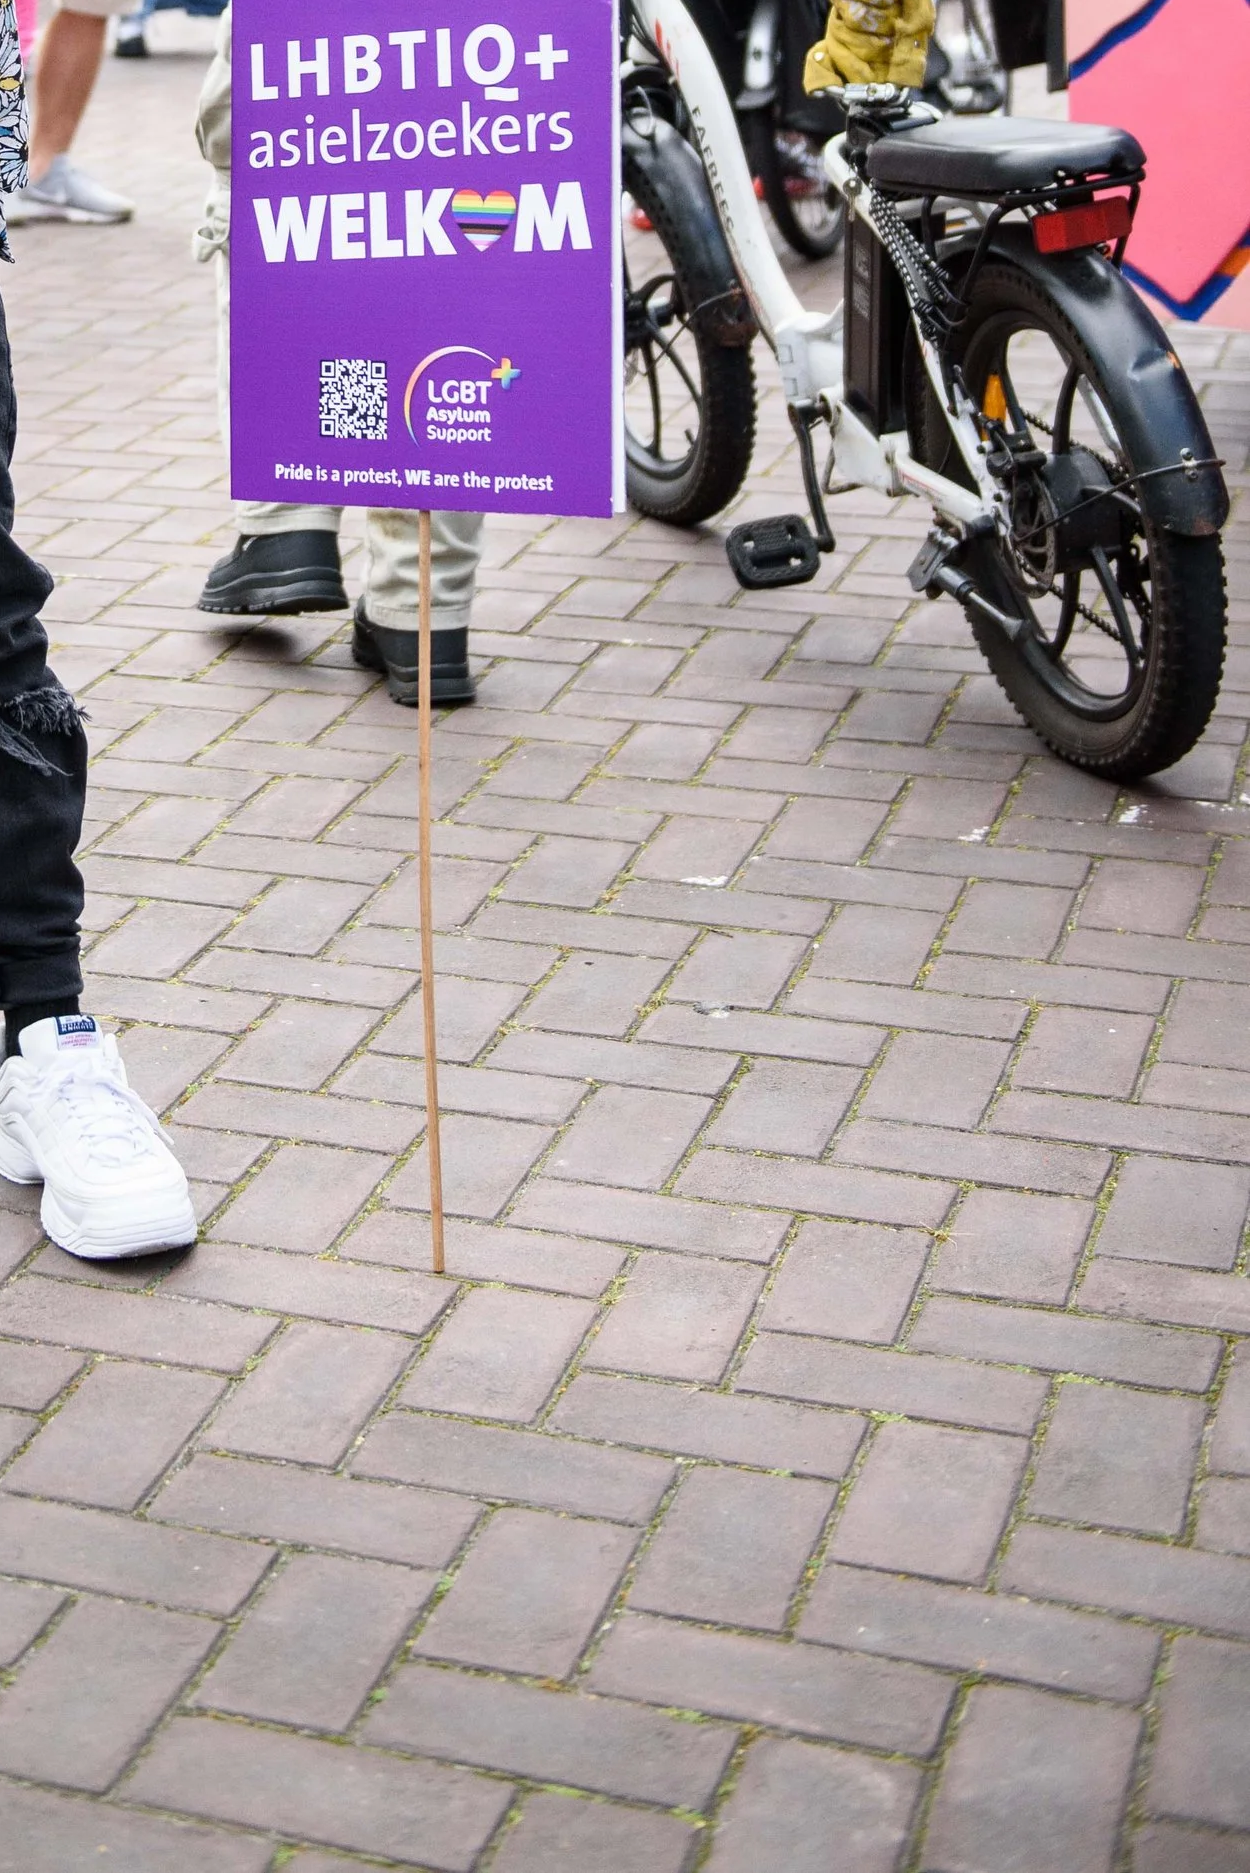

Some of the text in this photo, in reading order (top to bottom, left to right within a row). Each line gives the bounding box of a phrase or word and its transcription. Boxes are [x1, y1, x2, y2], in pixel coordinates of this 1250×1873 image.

[250, 23, 569, 101] LHBTIQ+
[249, 101, 574, 169] asielzoekers
[252, 180, 593, 263] WELKM
[426, 406, 491, 426] Asylum
[426, 425, 492, 444] Support
[274, 463, 554, 494] Pride is a protest, WE are the protest
